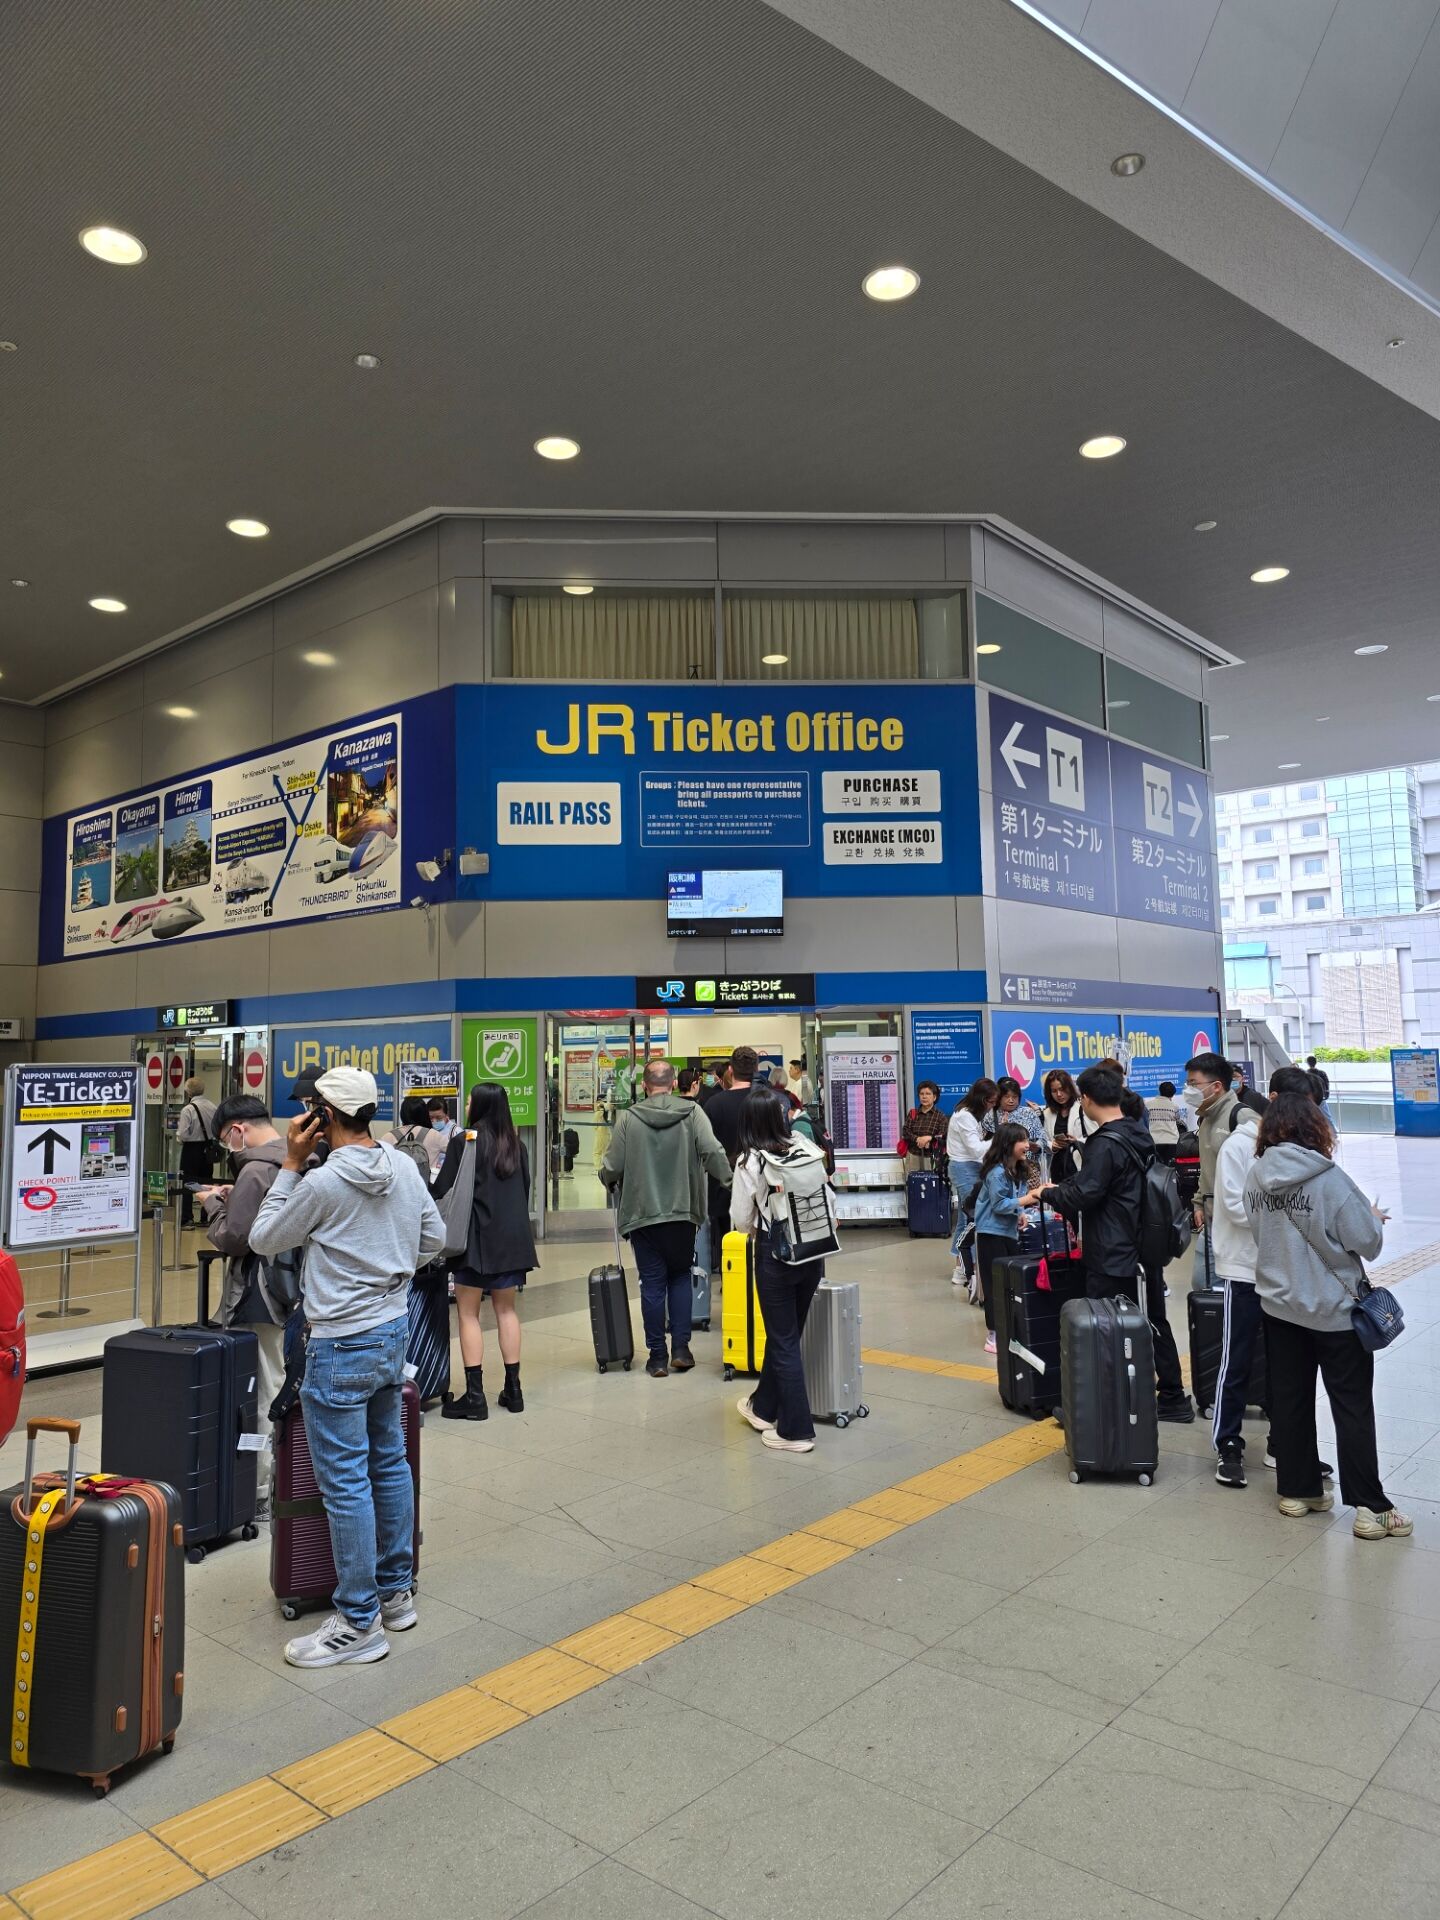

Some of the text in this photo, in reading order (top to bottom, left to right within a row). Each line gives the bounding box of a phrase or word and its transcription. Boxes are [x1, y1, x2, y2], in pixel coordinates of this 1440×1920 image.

[535, 703, 904, 755] JR Ticket Office
[333, 731, 392, 760] Kanazawa
[286, 770, 316, 785] Shin-Osaka
[1050, 748, 1079, 793] T1
[645, 780, 802, 790] Groups Please have one representative
[843, 778, 918, 793] PURCHASE
[175, 786, 203, 807] Himeji
[677, 790, 699, 800] bring
[700, 790, 711, 798] all
[713, 790, 752, 800] passports
[764, 790, 802, 800] purchase
[841, 796, 861, 807] 구입
[870, 796, 891, 807] 购买
[900, 796, 921, 807] 購買
[1146, 781, 1171, 821] T2
[677, 799, 708, 808] tickets.
[121, 803, 156, 824] Okayama
[509, 801, 611, 826] RAIL PASS
[75, 816, 111, 837] Hiroshima
[304, 820, 322, 832] Osaka
[1001, 801, 1102, 854] 第1ターミナル
[832, 828, 935, 844] EXCHANGE (MCO)
[844, 848, 864, 858] 교환
[1003, 839, 1070, 874] Terminal 1
[1131, 837, 1207, 878] 第2ターミナル
[356, 878, 387, 893] Hokuriku
[668, 873, 696, 883] 阪和線
[1056, 880, 1095, 902] 제1터미널
[1162, 874, 1209, 902] Terminal 2
[355, 890, 397, 904] Shinkansen
[224, 903, 264, 918] Kansai-airport
[66, 924, 81, 935] Sanyo
[66, 933, 92, 945] Shinkansen
[656, 981, 685, 998] JR
[719, 980, 782, 991] きっぷうりば
[719, 992, 748, 1000] Tickets
[162, 1009, 174, 1023] JR
[484, 1032, 519, 1041] みどりの窓口
[1039, 1025, 1162, 1062] JR Ticket Office
[282, 1041, 321, 1078] JR
[324, 1044, 379, 1075] Ticket
[850, 1056, 878, 1065] はるか
[862, 1070, 895, 1078] HARUKA
[23, 1080, 131, 1104] 【E-Ticket】
[18, 1175, 76, 1187] CHECK POINT!!
[149, 1175, 164, 1185] 入口
